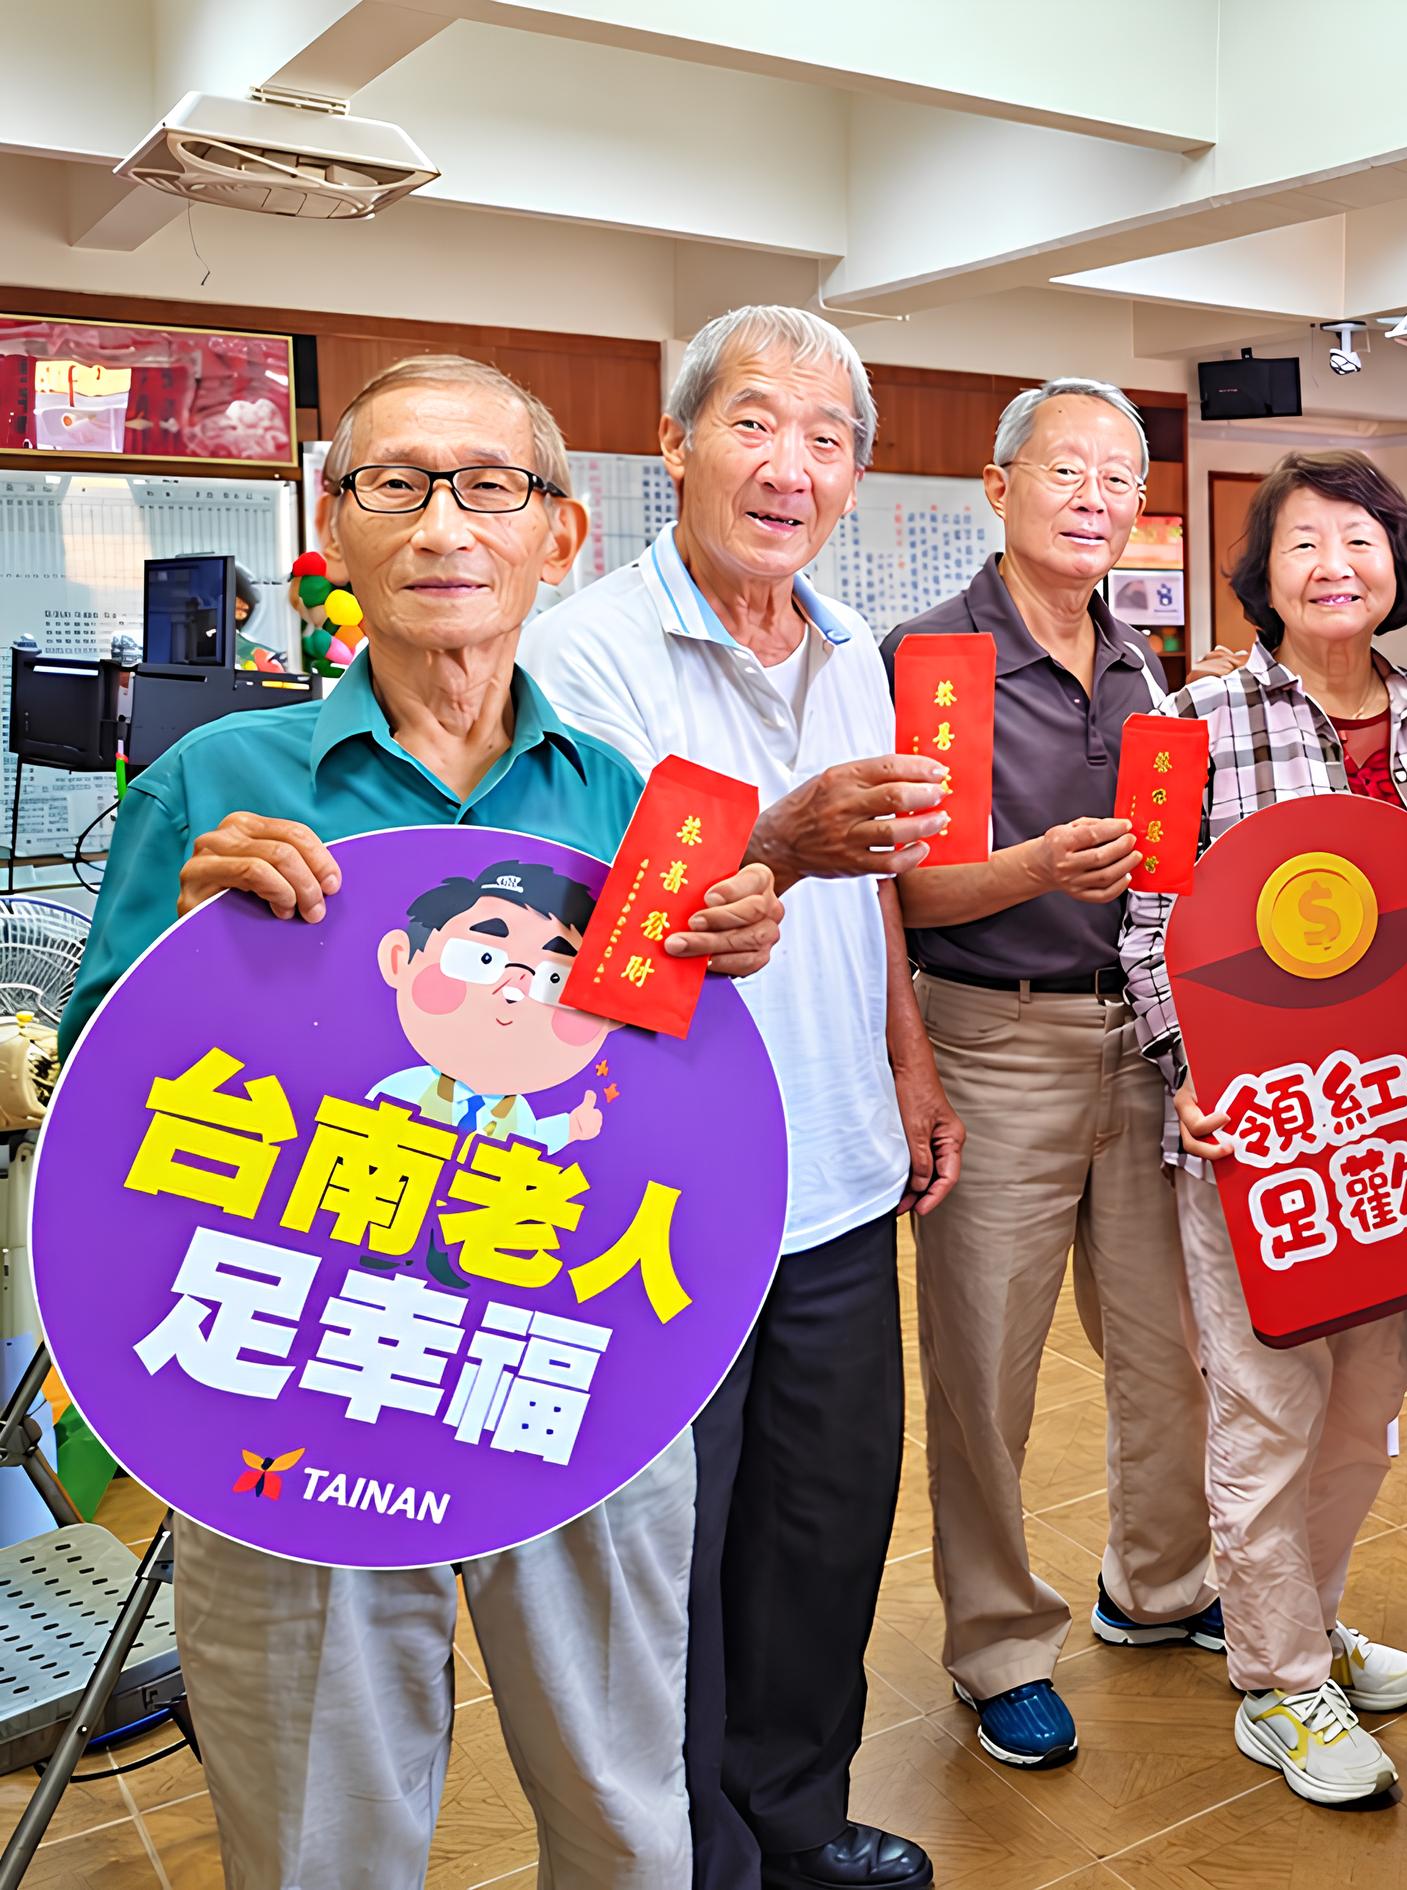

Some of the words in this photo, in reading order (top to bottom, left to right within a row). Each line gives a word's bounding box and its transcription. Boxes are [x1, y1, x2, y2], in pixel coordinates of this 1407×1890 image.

[123, 1046, 694, 1325] 台南老人
[132, 1225, 614, 1467] 足幸福
[302, 1466, 452, 1525] TAINAN
